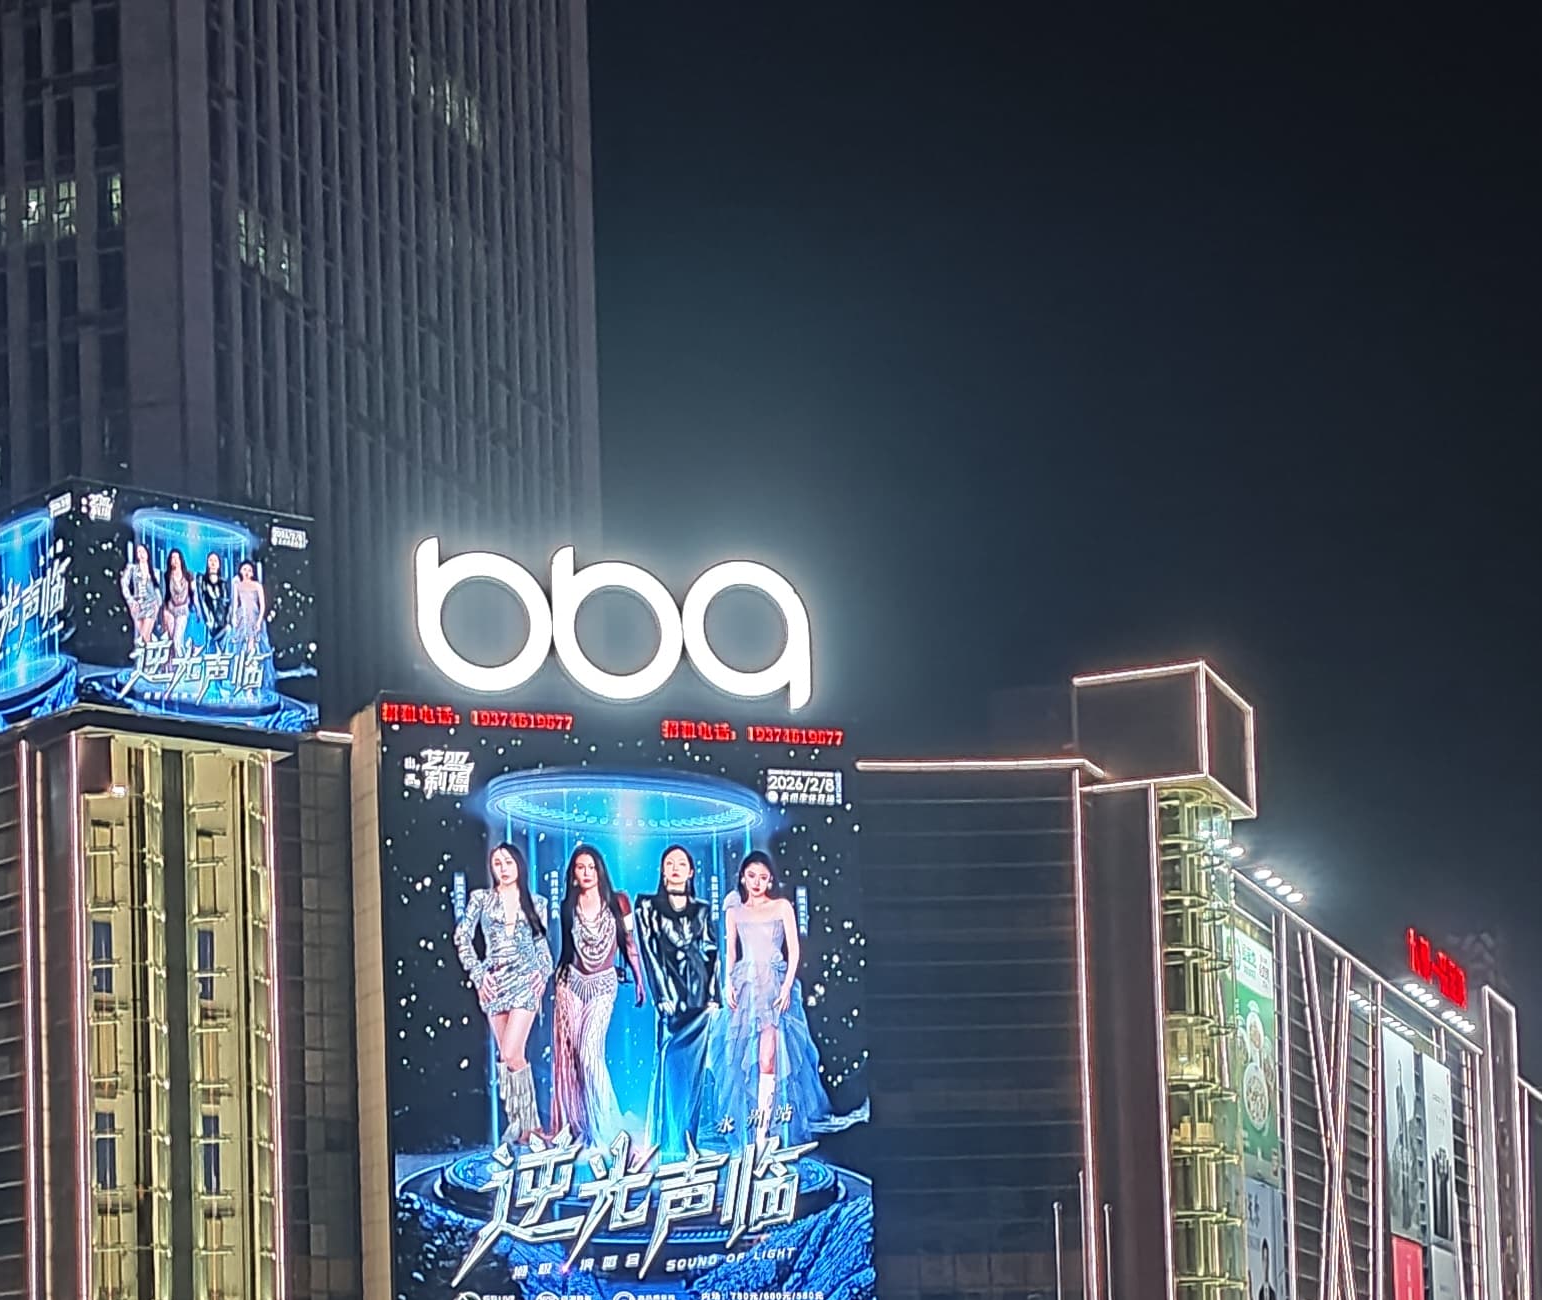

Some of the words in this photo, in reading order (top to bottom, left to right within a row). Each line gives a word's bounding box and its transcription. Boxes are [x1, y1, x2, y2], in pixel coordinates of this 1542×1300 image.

[767, 775, 835, 794] 2026/2/8
[451, 1128, 820, 1287] 逆光声临
[665, 1254, 718, 1272] SOUND
[725, 1251, 745, 1264] OF
[753, 1246, 797, 1261] LIGHT
